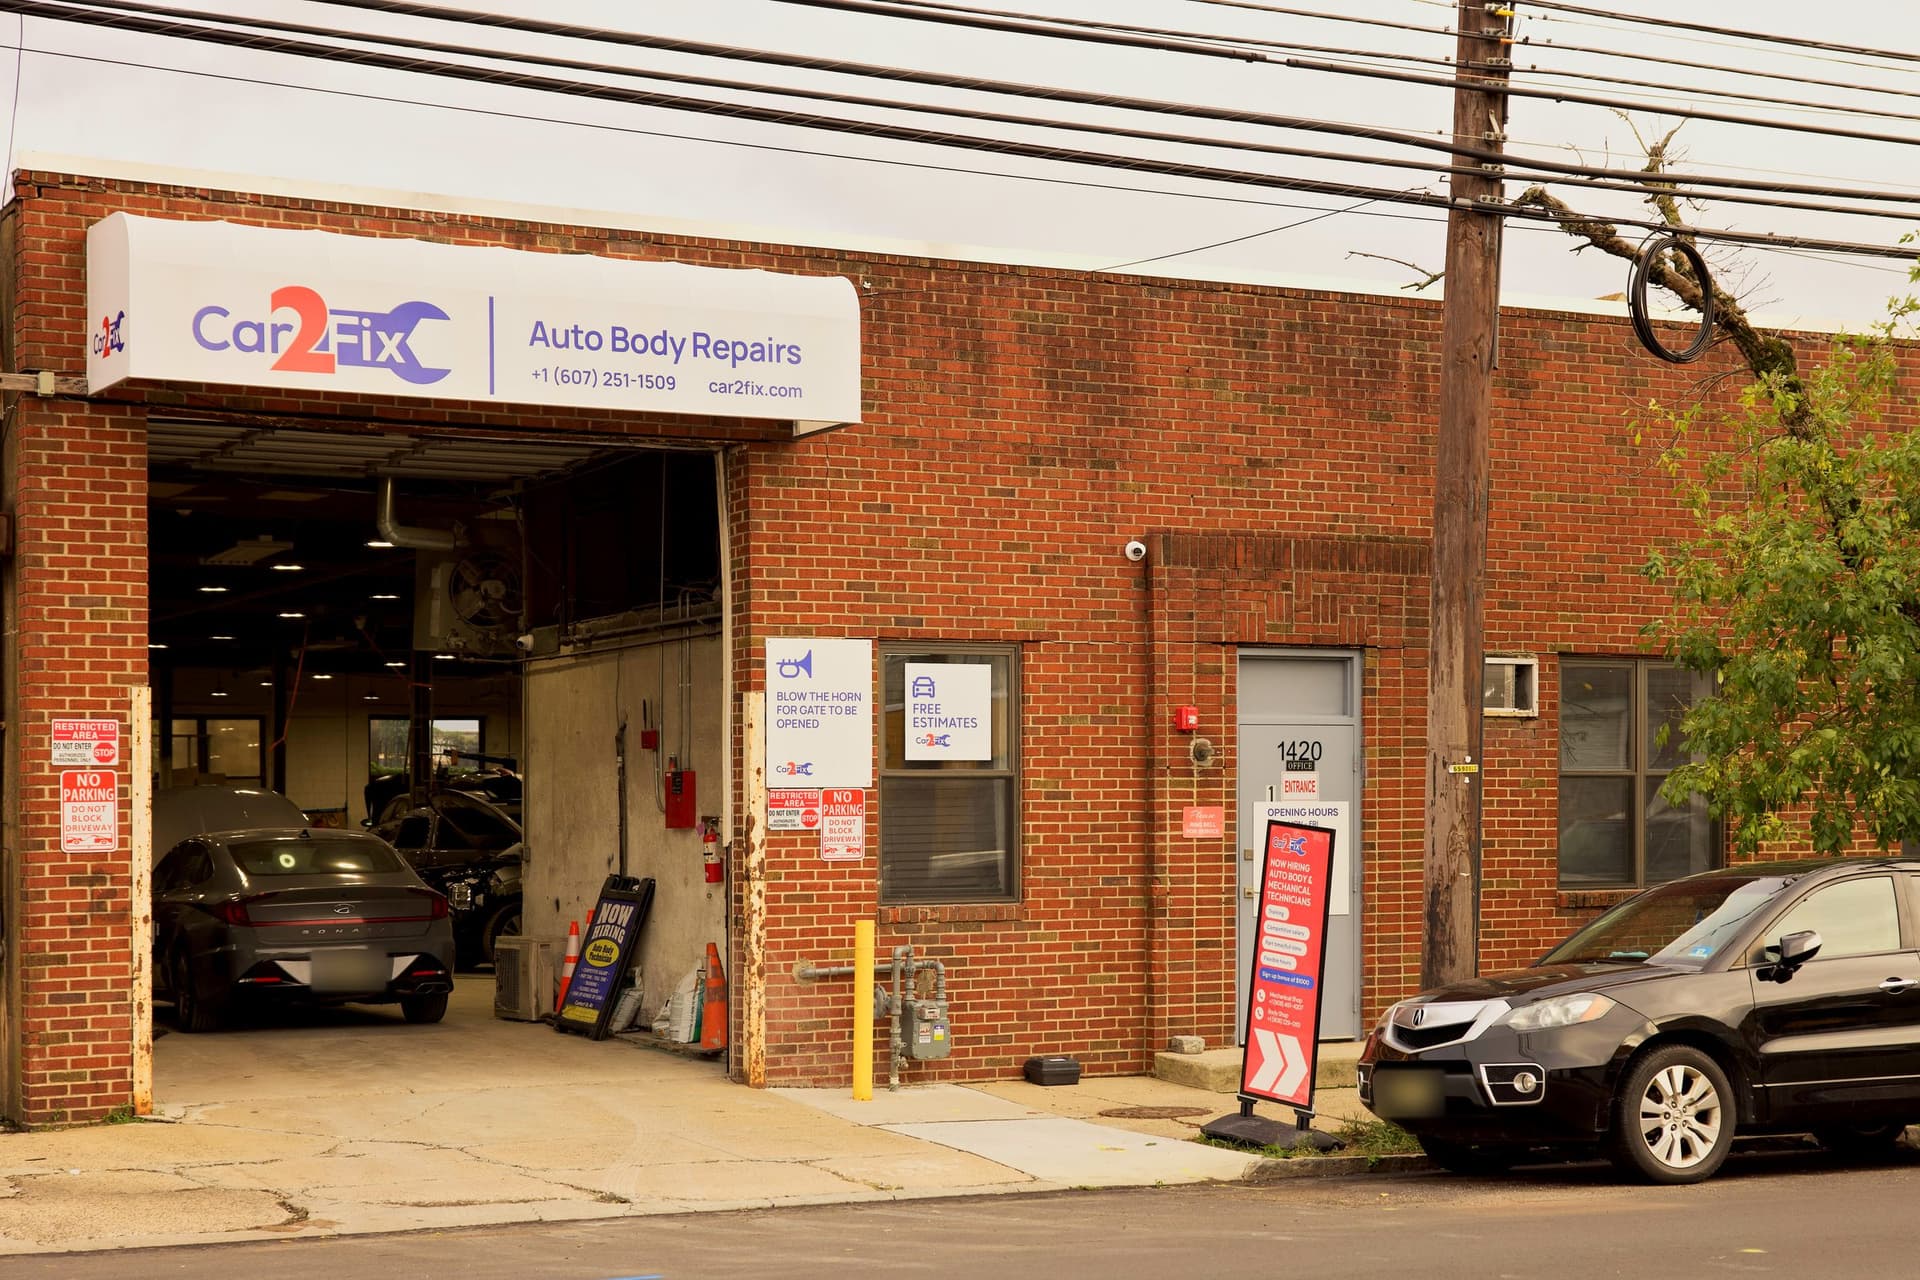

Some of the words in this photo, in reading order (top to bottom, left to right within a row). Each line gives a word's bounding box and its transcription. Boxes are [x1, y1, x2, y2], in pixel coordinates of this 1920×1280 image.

[192, 285, 412, 377] Car2Fix
[529, 320, 603, 351] Auto
[610, 326, 687, 364] Body
[692, 332, 802, 369] Repairs
[531, 367, 549, 382] +1
[553, 366, 598, 388] (607)
[602, 371, 676, 391] 251-1509
[708, 379, 802, 398] car2fix.com
[776, 691, 808, 701] BLOW
[809, 691, 829, 701] THE
[831, 692, 862, 702] HORN
[776, 705, 798, 715] FOR
[799, 705, 827, 715] GATE
[828, 705, 843, 715] TO
[844, 705, 857, 715] BE
[913, 703, 941, 714] FREE
[54, 723, 116, 731] RESTRICTED
[776, 719, 820, 728] OPENED
[913, 717, 978, 728] ESTIMATES
[72, 732, 98, 740] AREA
[53, 742, 62, 750] DO
[62, 742, 73, 750] NOT
[74, 742, 92, 750] ENTER
[1277, 740, 1322, 761] 1420
[94, 748, 115, 758] STOP
[1288, 762, 1313, 770] OFFICE
[77, 773, 101, 787] NO
[1284, 780, 1316, 793] ENTRANCE
[63, 788, 114, 801] PARKING
[770, 791, 818, 800] RESTRICTED
[833, 791, 852, 803] NO
[1268, 785, 1274, 802] 1
[71, 805, 86, 813] DO
[87, 805, 107, 813] NOT
[785, 809, 800, 817] ENTER
[823, 804, 862, 816] PARKING
[1267, 808, 1307, 817] OPENING
[1308, 808, 1339, 817] HOURS
[801, 815, 818, 823] STOP
[66, 824, 113, 832] DRIVEWAY
[1270, 858, 1287, 868] NOW
[1287, 860, 1311, 873] HIRING
[1269, 868, 1288, 880] AUTO
[1288, 872, 1308, 883] BODY
[1267, 879, 1311, 896] MECHANICAL
[1267, 891, 1312, 907] TECHNICIANS
[596, 902, 635, 928] NOW
[591, 924, 626, 945] HIRING
